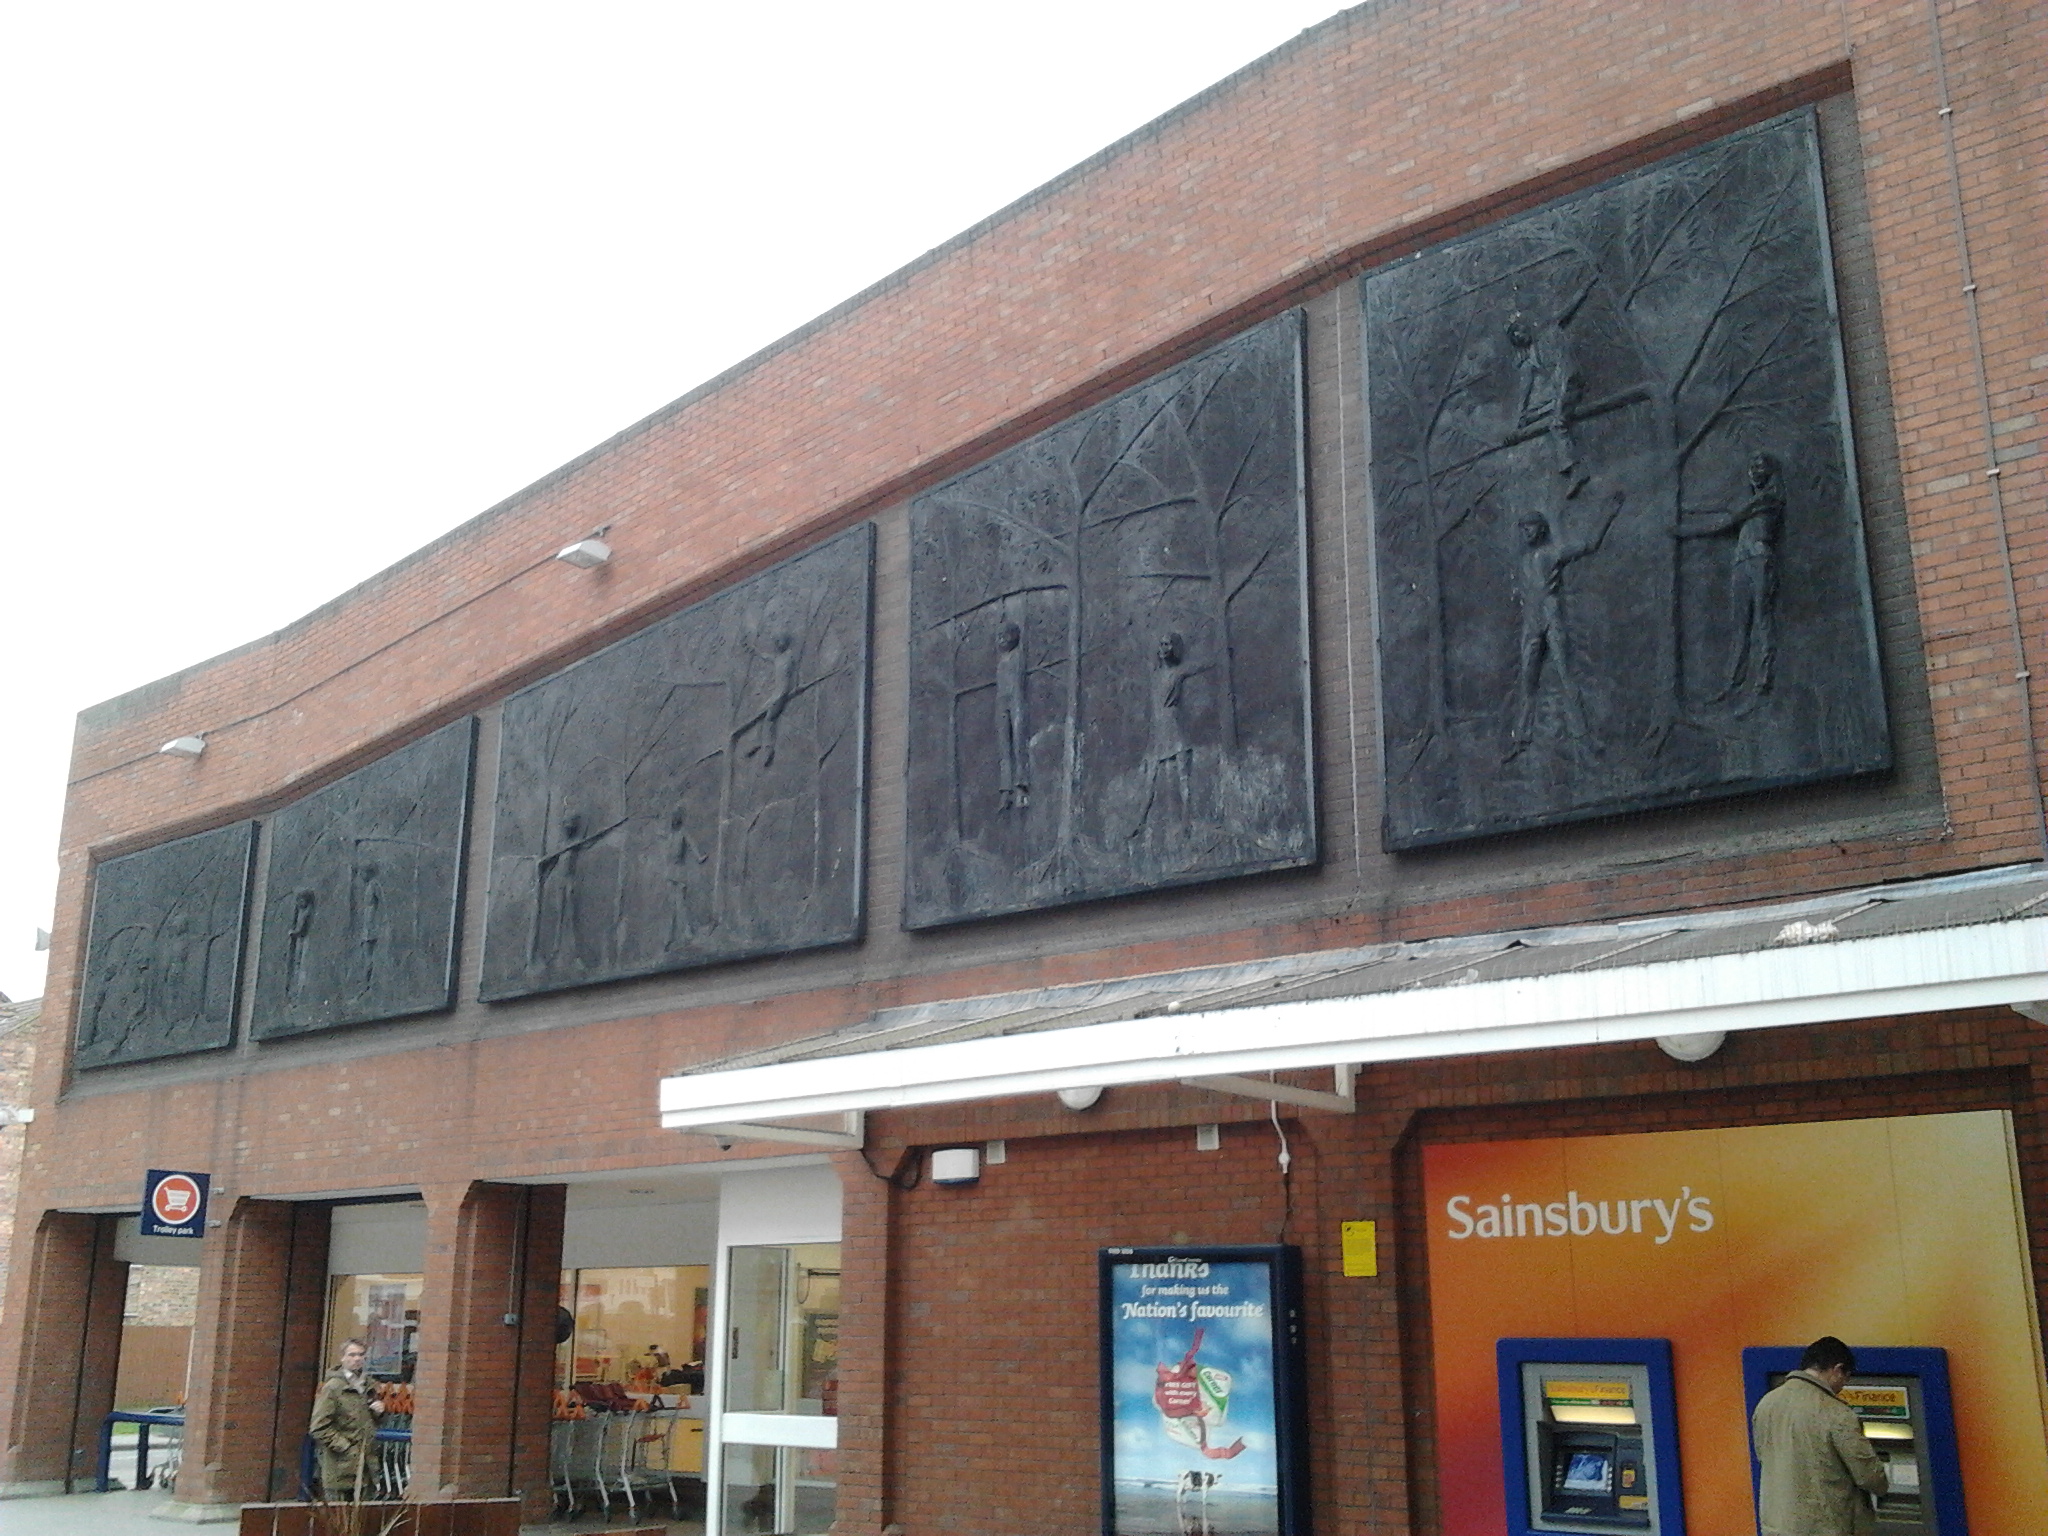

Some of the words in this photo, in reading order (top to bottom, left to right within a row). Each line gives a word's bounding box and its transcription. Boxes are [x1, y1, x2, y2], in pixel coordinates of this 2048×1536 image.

[1446, 1186, 1714, 1245] Sainsbury's
[152, 1225, 177, 1234] Trolley
[1141, 1285, 1156, 1298] for
[1158, 1284, 1196, 1298] making
[1197, 1286, 1210, 1295] us
[1212, 1284, 1229, 1295] the
[1121, 1302, 1187, 1320] Nation's
[1189, 1301, 1265, 1322] favourite
